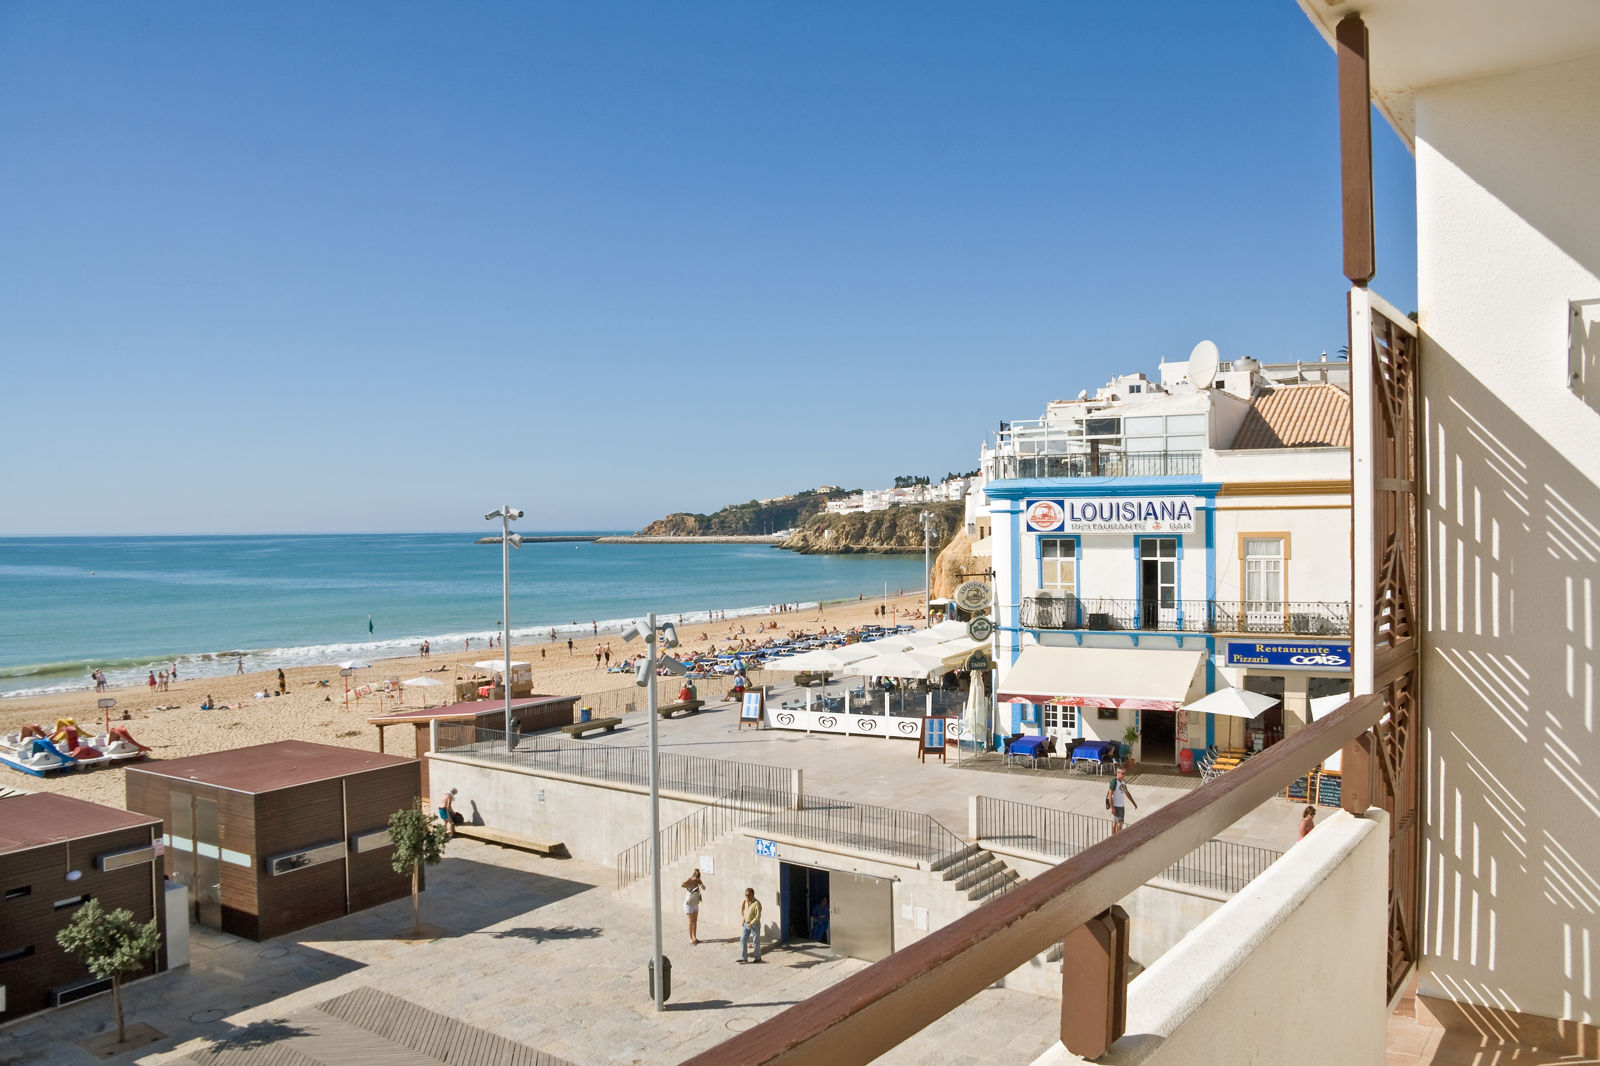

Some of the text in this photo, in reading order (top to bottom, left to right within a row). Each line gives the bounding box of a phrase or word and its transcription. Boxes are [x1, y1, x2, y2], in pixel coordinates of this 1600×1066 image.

[1070, 501, 1192, 522] LOUISIANA
[1169, 522, 1192, 530] BAR
[1256, 644, 1329, 654] Restaurante
[1233, 654, 1269, 664] Pizzaria
